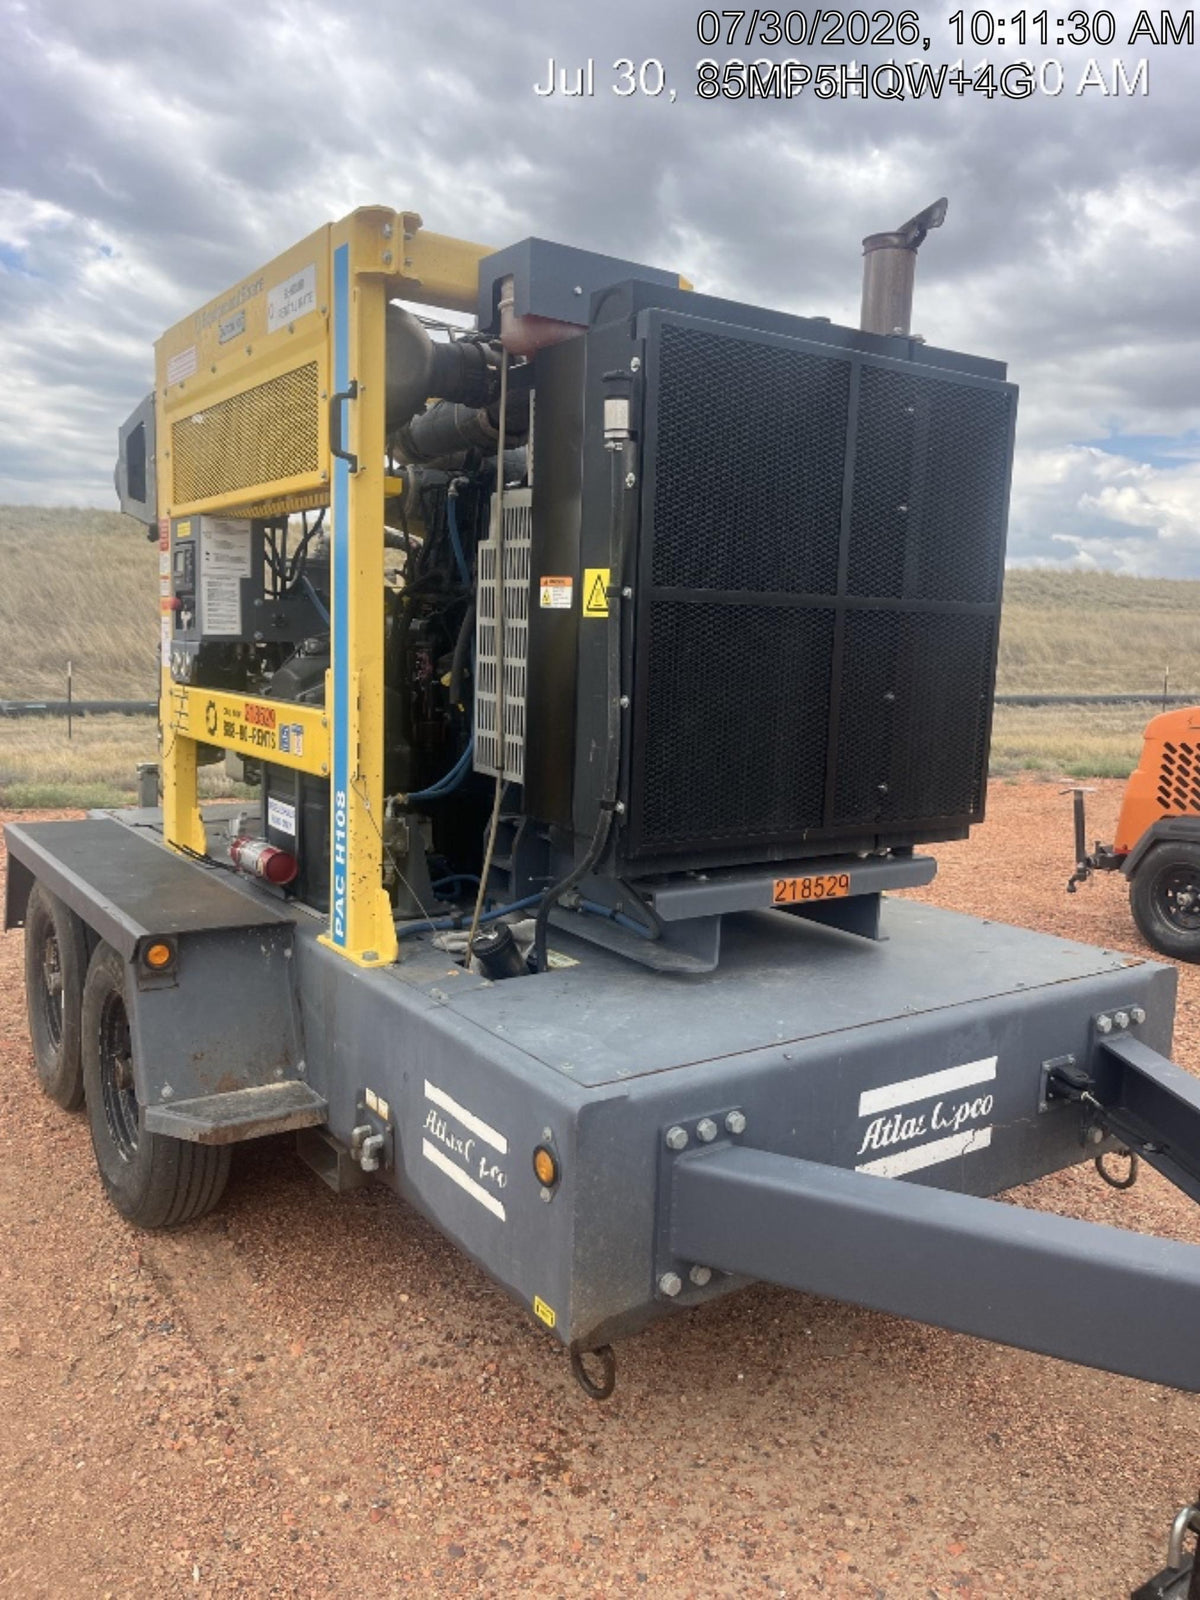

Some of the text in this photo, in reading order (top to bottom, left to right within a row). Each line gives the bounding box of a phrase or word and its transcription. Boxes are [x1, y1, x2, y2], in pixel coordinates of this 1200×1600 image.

[334, 790, 346, 938] PAC H108
[774, 874, 849, 902] 218529
[856, 1113, 927, 1156] Atlas
